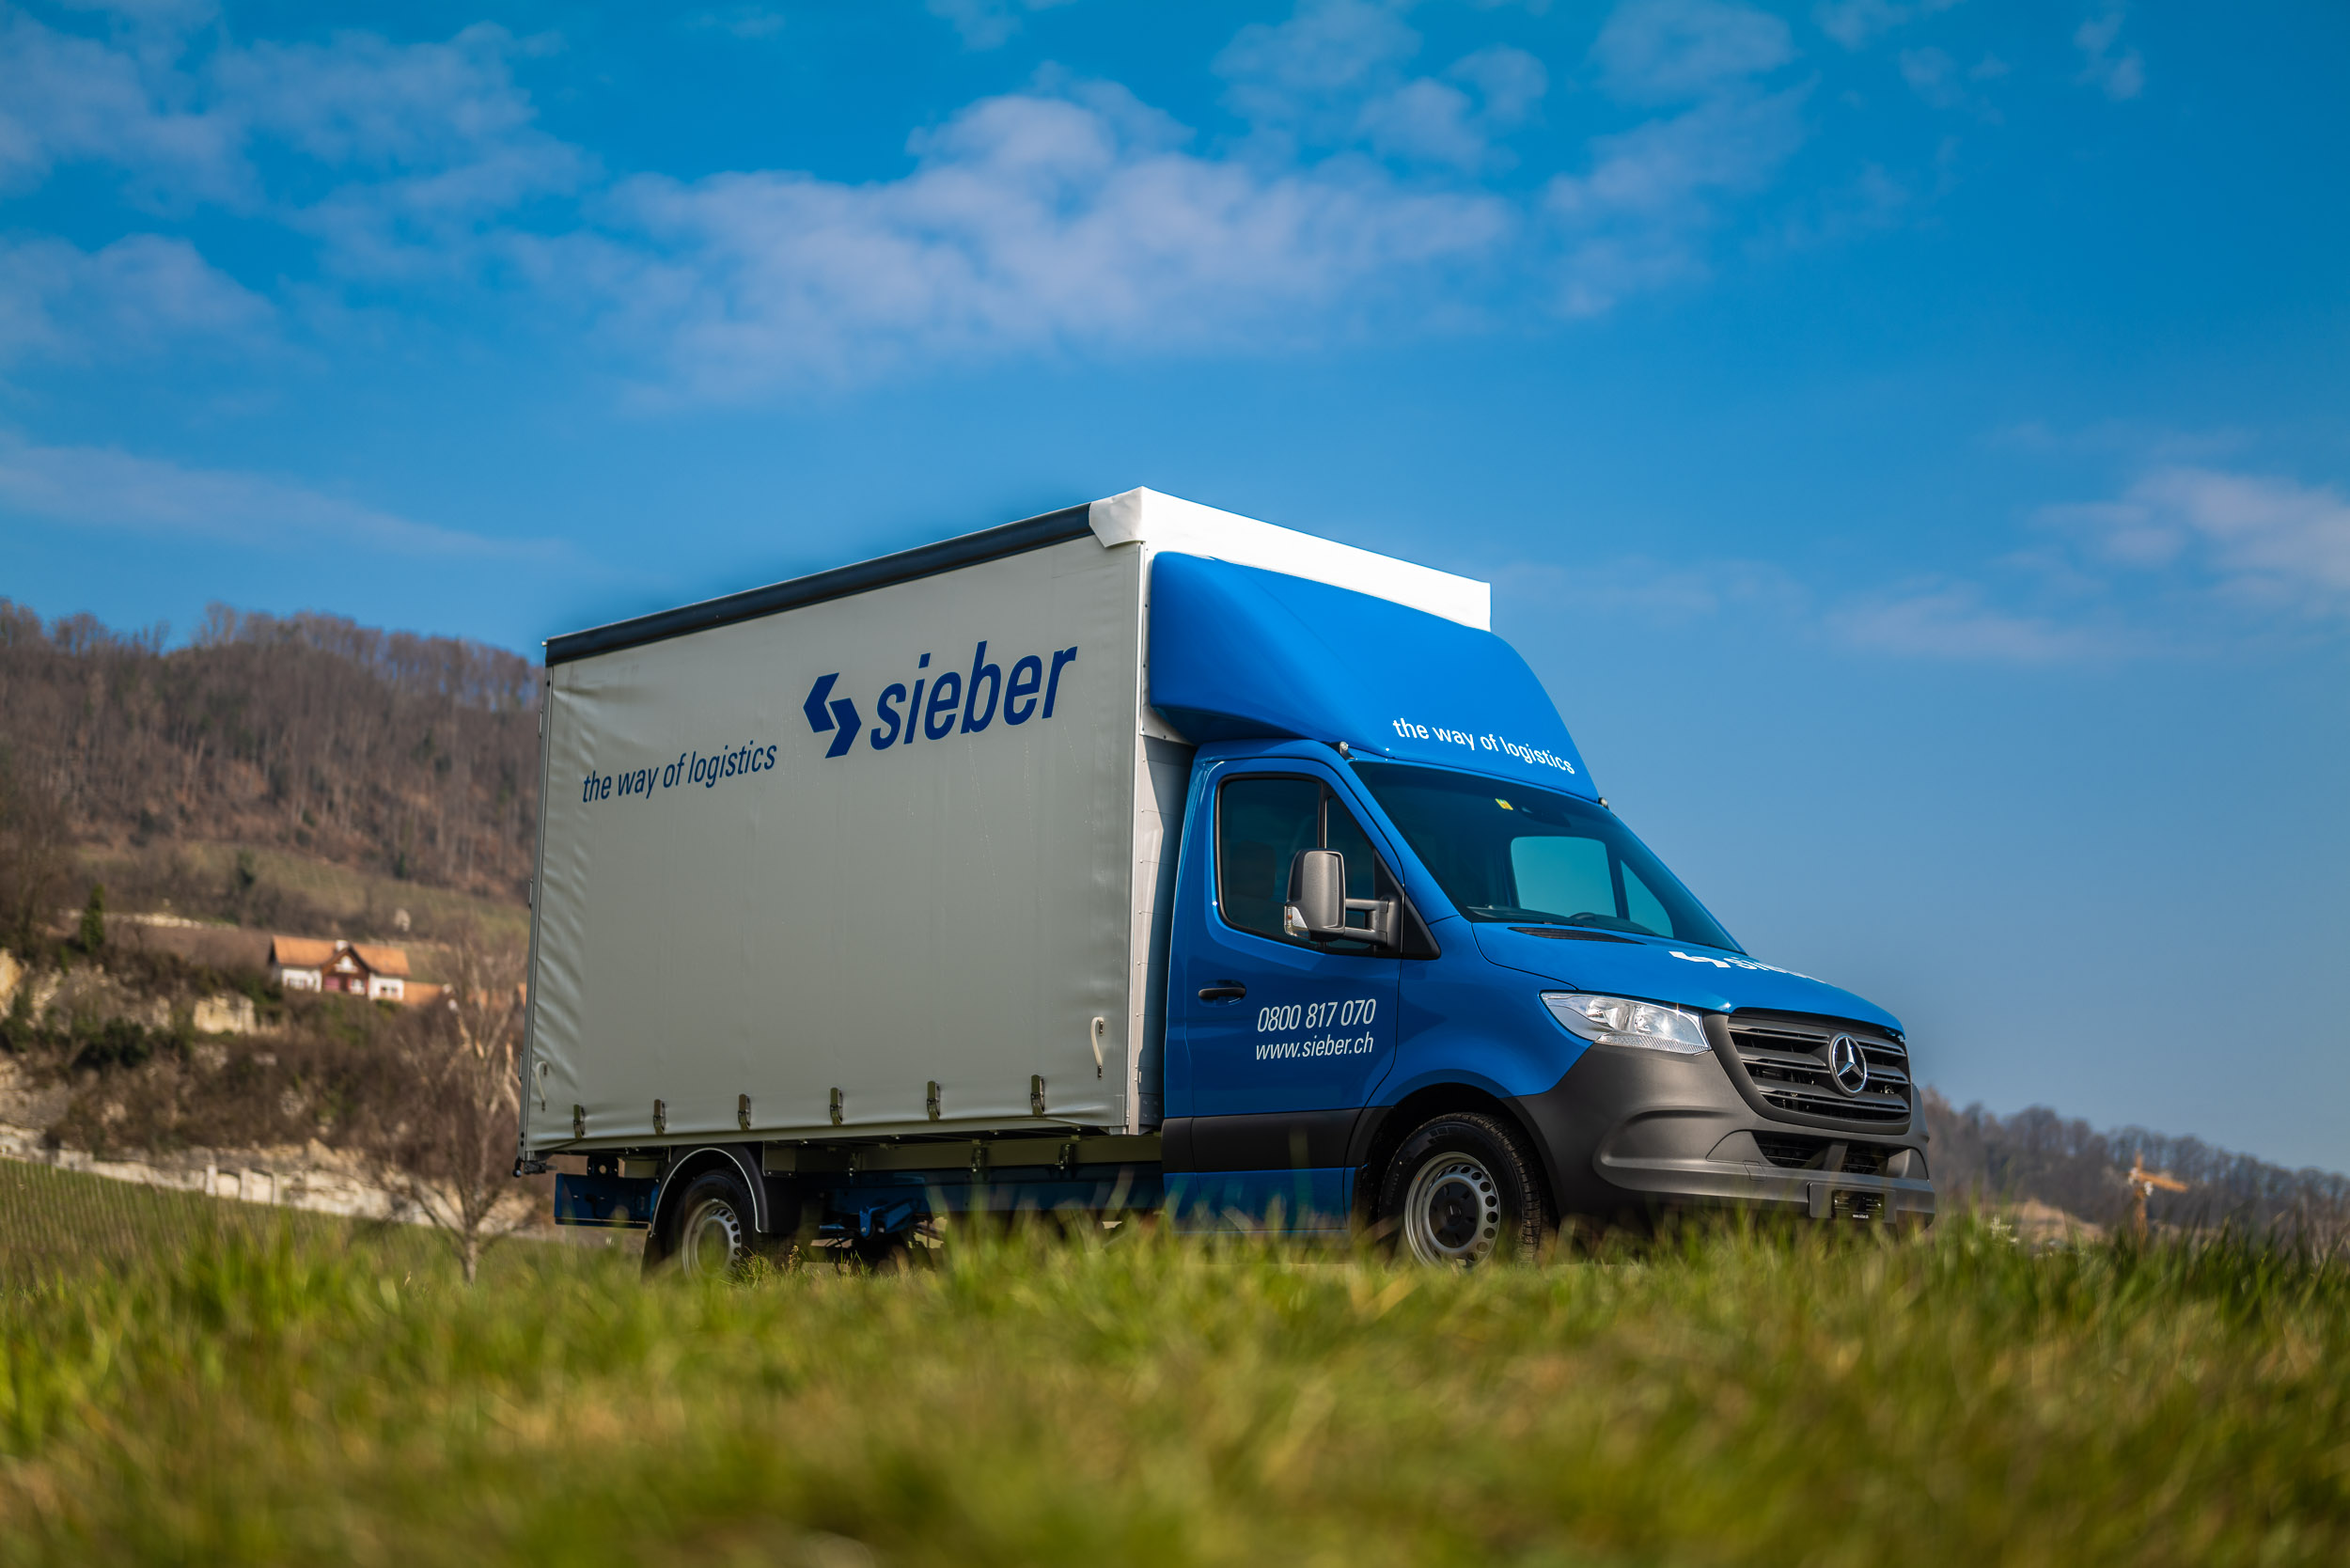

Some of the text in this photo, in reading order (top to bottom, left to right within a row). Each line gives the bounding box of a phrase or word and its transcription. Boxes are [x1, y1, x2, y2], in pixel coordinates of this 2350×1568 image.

[870, 639, 1078, 751] sieber
[582, 739, 777, 804] the way of logistics
[1392, 717, 1575, 775] the way of logistics
[1257, 997, 1377, 1033] 0800 817 070
[1256, 1030, 1374, 1060] www.sieber.ch
